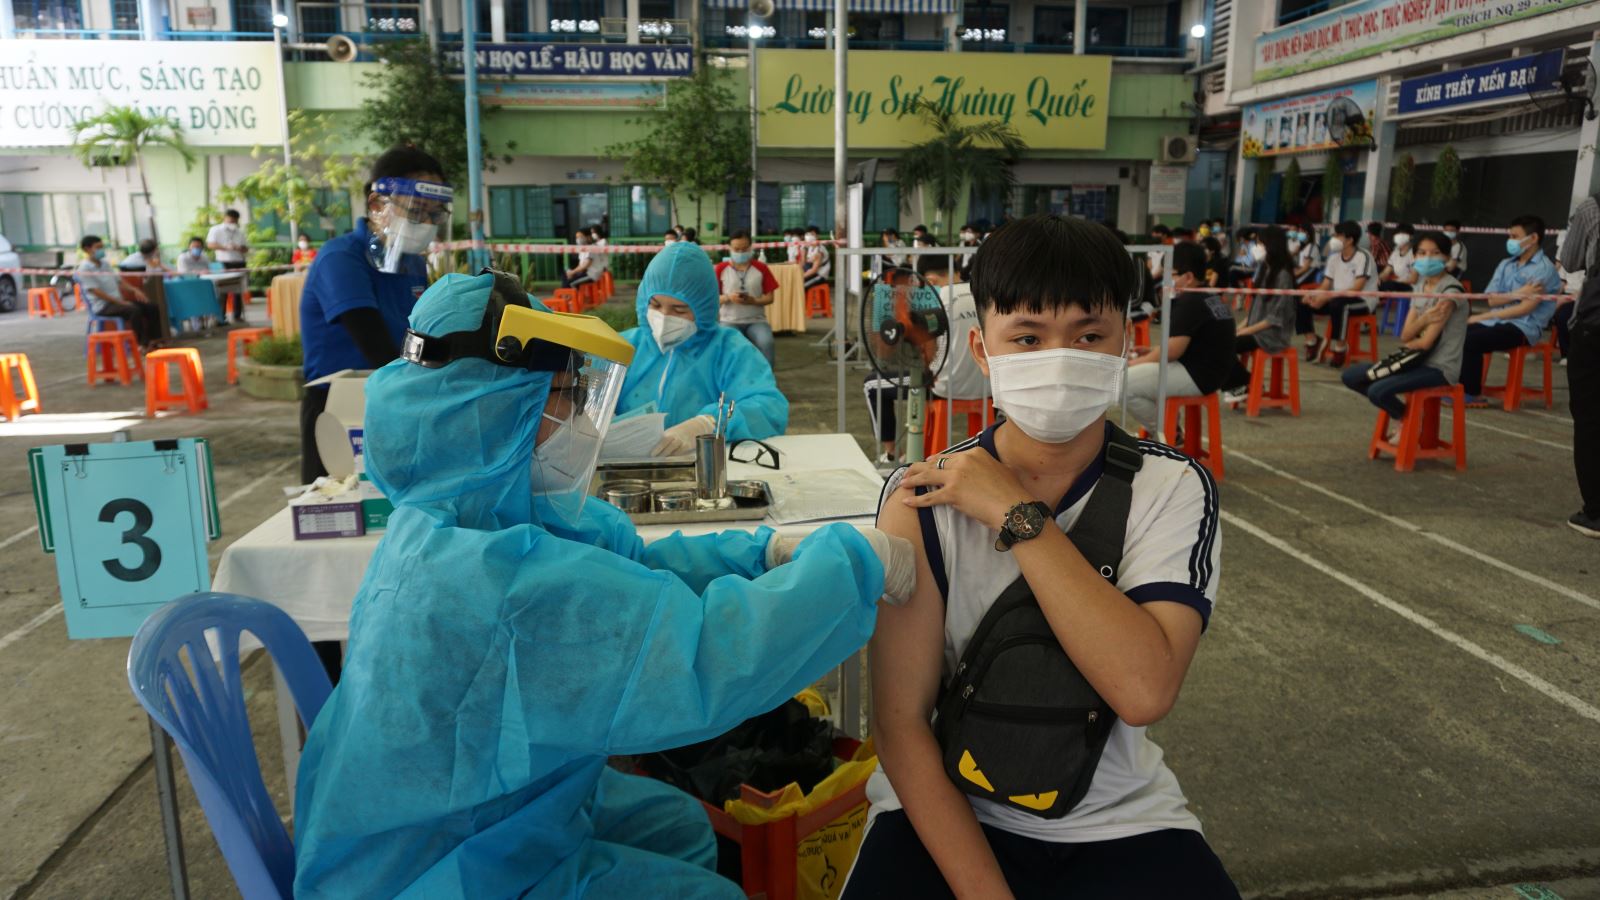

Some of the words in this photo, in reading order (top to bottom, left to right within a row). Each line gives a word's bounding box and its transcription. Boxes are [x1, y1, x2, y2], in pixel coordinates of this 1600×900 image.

[1496, 4, 1514, 17] NQ
[67, 62, 130, 96] MỰC,
[139, 60, 204, 91] SÁNG
[214, 66, 262, 96] TẠO
[489, 50, 527, 72] HỌC
[564, 47, 603, 73] HẬU
[609, 51, 646, 73] HỌC
[652, 48, 689, 69] VĂN
[932, 75, 1016, 125] Hưng
[1026, 76, 1096, 126] Quốc
[1416, 83, 1441, 103] KÍNH
[1445, 73, 1475, 99] THẦY
[1509, 67, 1537, 89] BẠN
[190, 99, 256, 135] ĐỘNG
[98, 498, 162, 582] 3
